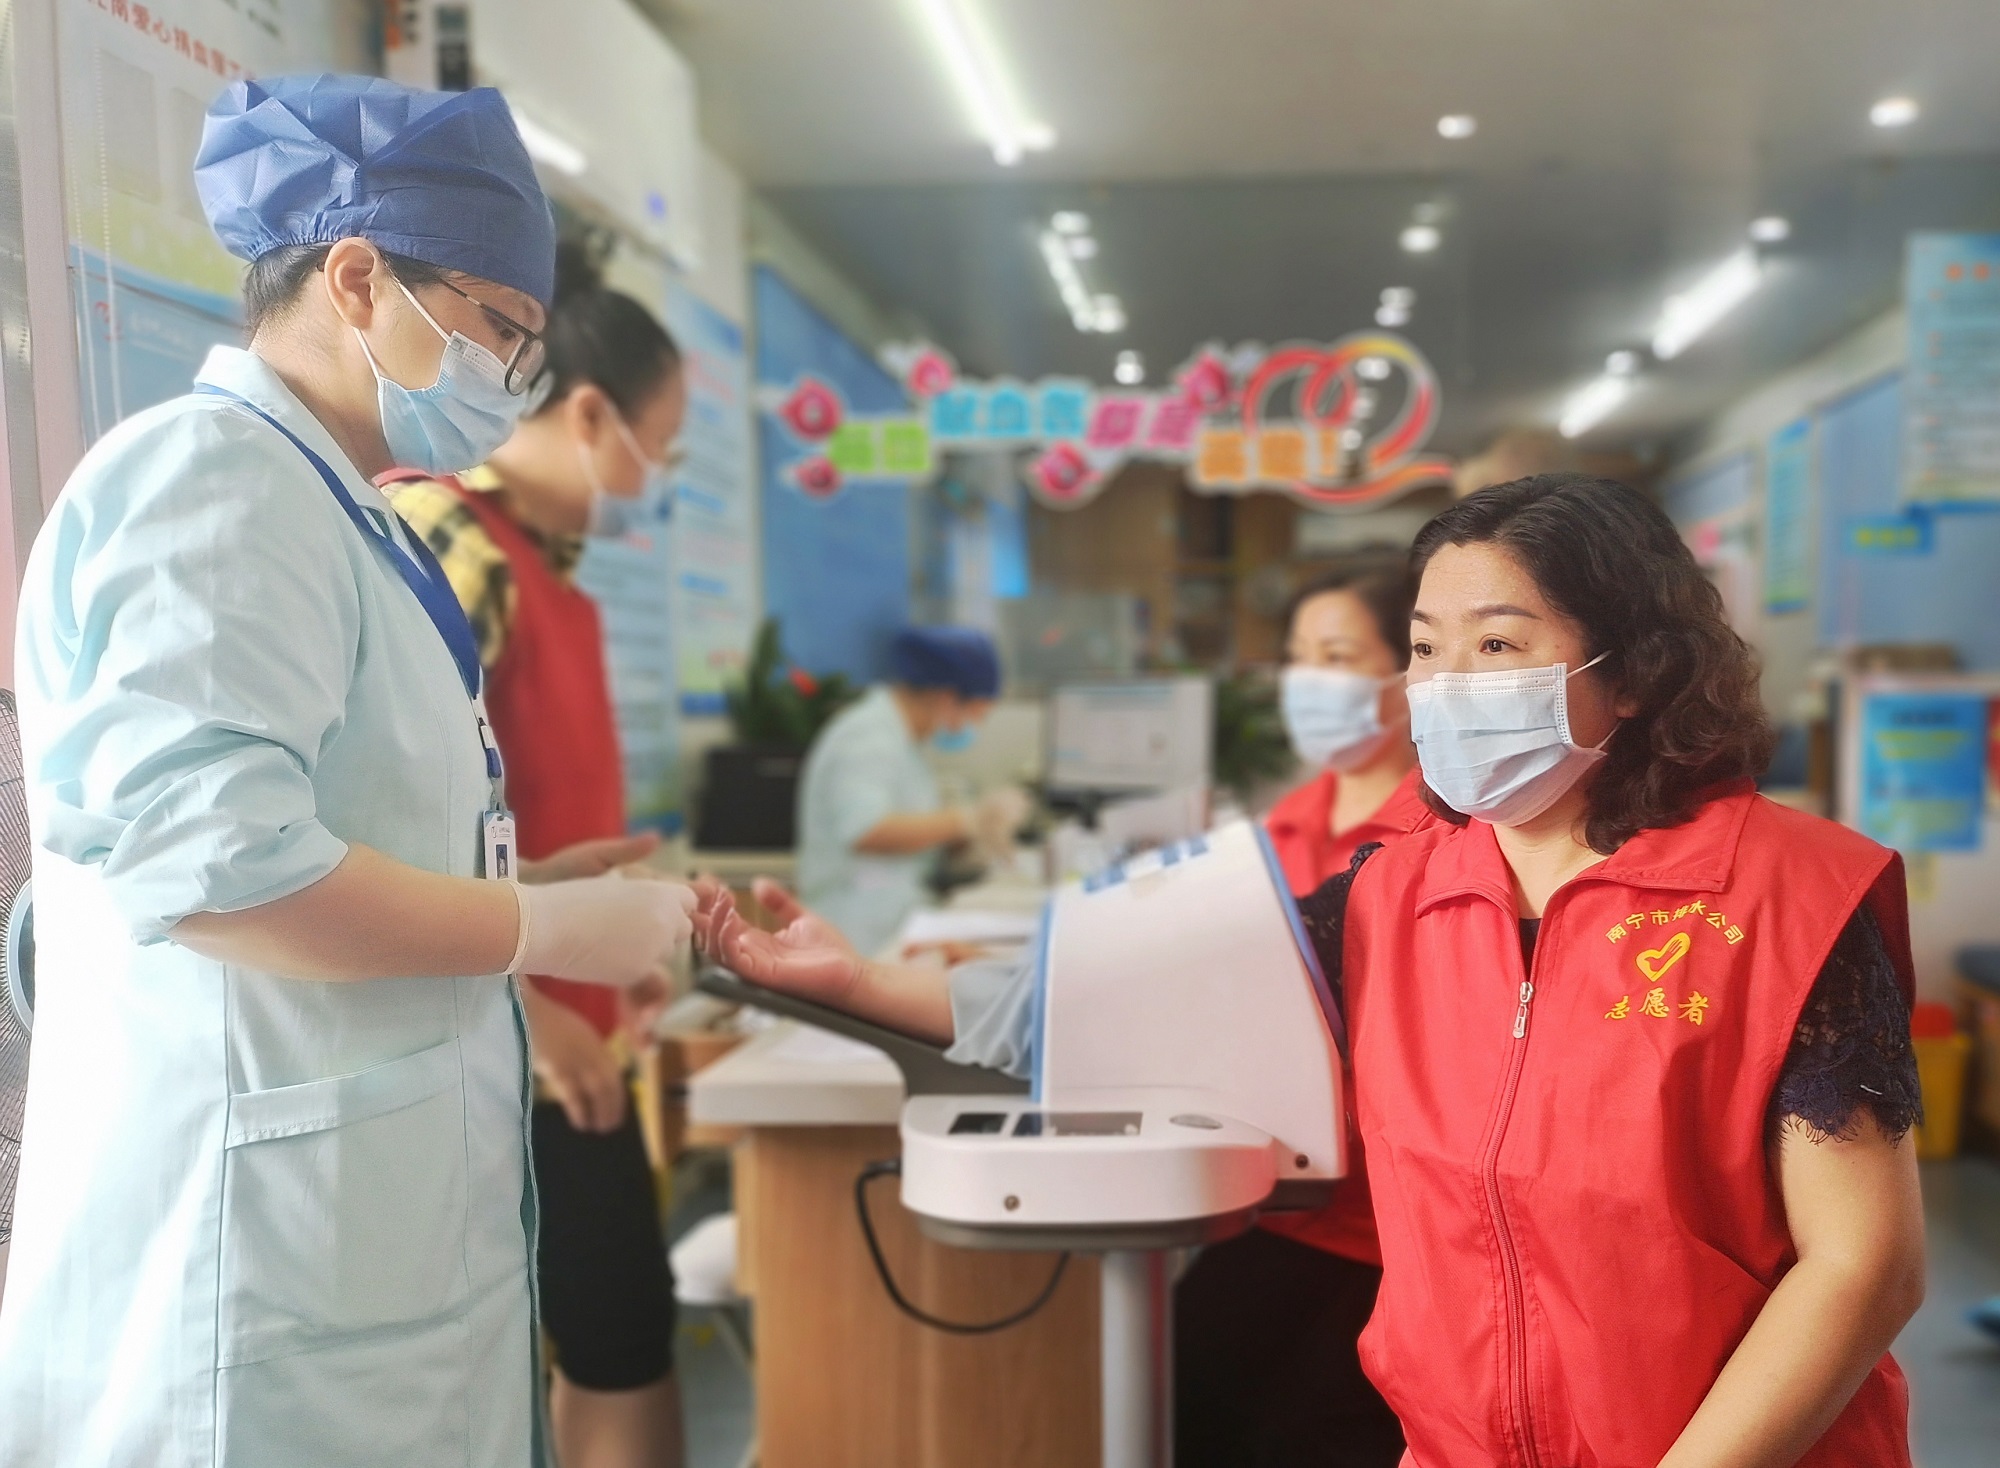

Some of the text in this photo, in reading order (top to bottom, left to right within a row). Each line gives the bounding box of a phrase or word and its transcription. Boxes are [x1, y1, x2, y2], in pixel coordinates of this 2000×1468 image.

[1605, 900, 1745, 946] 南宁市排水公司
[1604, 986, 1709, 1026] 志愿者
